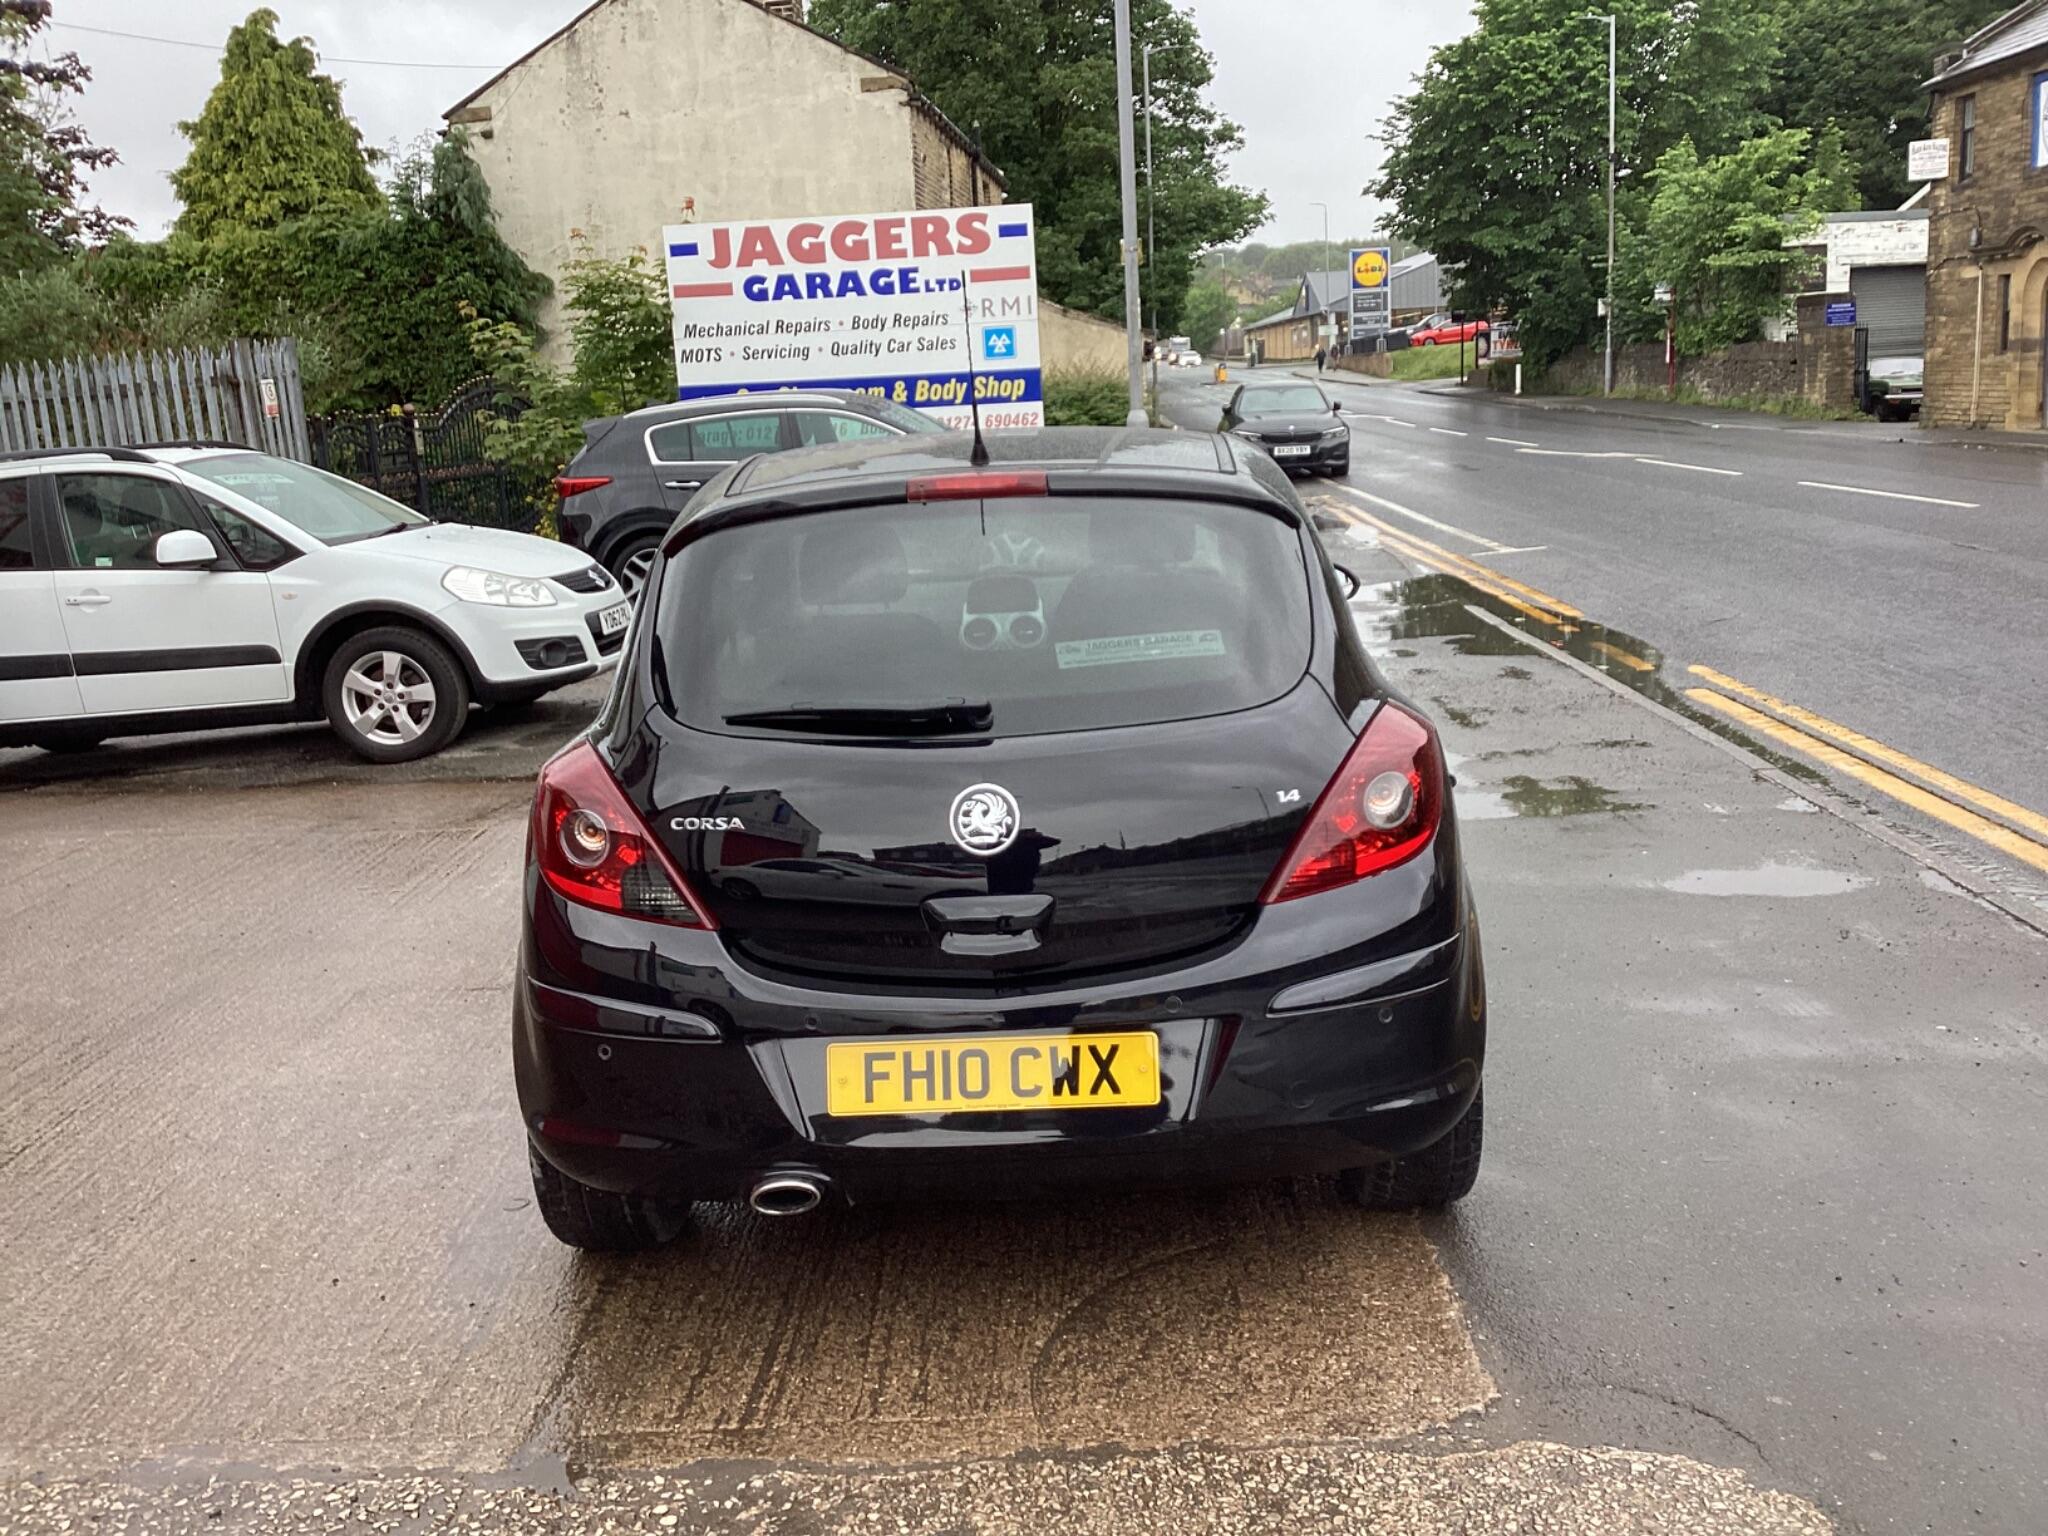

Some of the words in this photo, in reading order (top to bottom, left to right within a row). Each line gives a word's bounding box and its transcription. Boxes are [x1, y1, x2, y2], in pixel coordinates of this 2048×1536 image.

[707, 212, 991, 269] JAGGERS
[743, 266, 921, 302] GARAGE
[925, 278, 961, 293] LTD
[982, 295, 1032, 318] RMI
[684, 320, 770, 339] Mechanical
[775, 317, 831, 336] Repairs
[851, 314, 887, 332] Body
[892, 311, 949, 330] Repairs
[681, 347, 722, 363] MOTS
[742, 345, 810, 361] Servicing
[831, 340, 882, 357] Quality
[887, 338, 912, 353] Car
[917, 336, 957, 352] Sales
[892, 380, 907, 402] &
[915, 378, 967, 404] Body
[974, 376, 1026, 401] Shop
[985, 412, 1039, 428] 690462
[670, 817, 745, 830] CORSA
[864, 1048, 990, 1104] FH10
[1010, 1044, 1121, 1098] CWX
